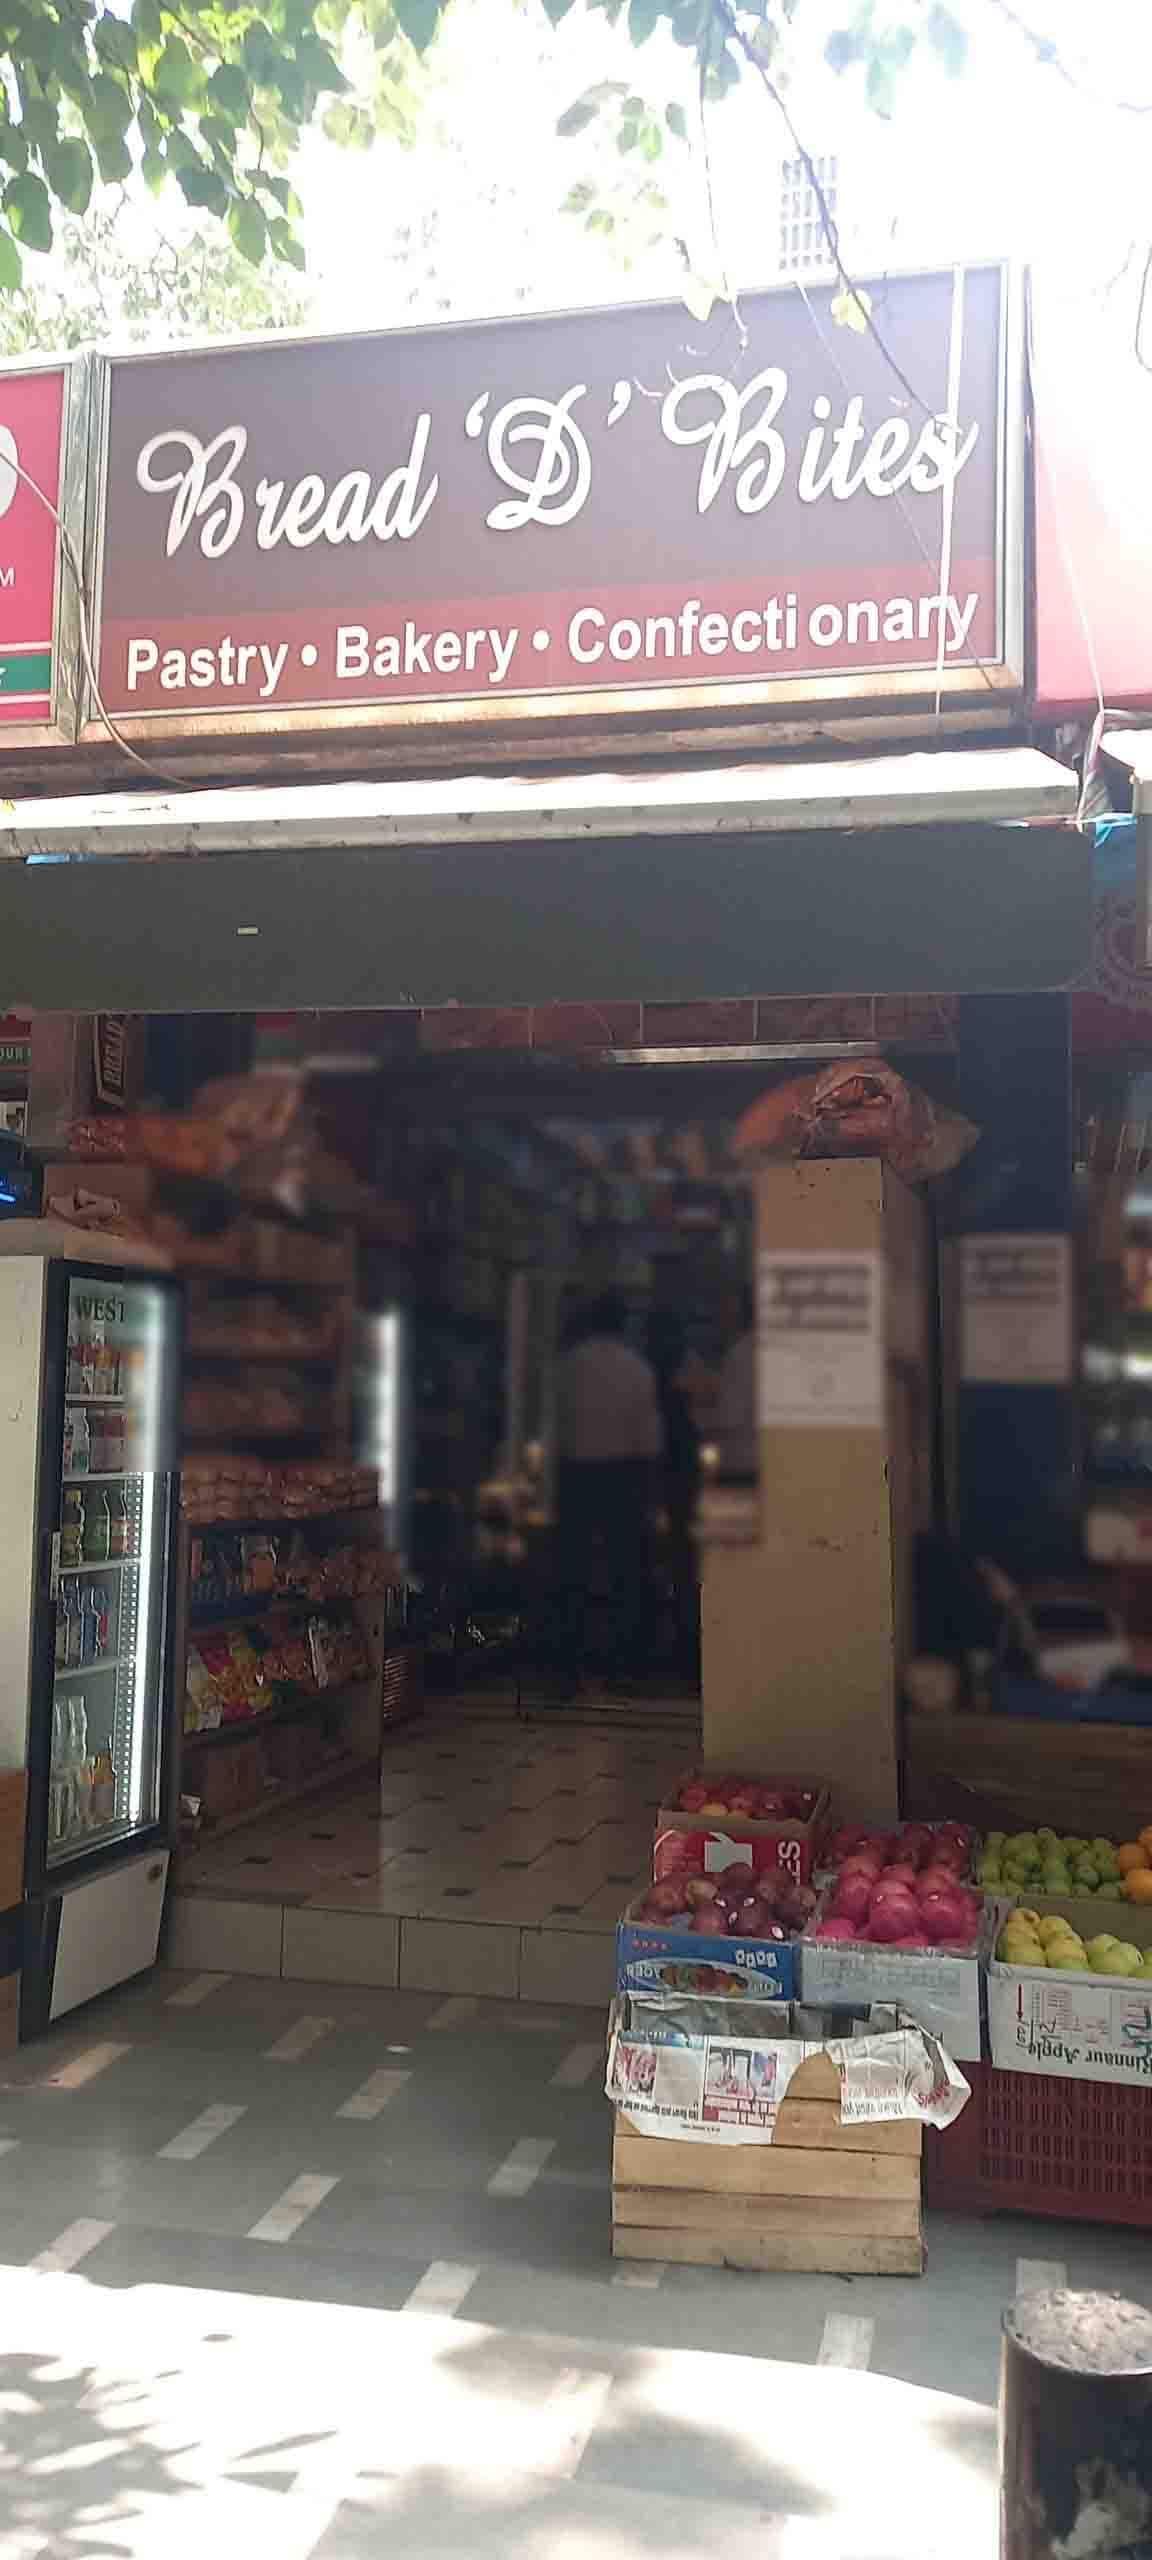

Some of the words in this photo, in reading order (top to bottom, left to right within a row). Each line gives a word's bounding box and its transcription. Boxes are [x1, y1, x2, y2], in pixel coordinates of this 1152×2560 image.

[136, 412, 438, 558] Bread
[661, 367, 979, 513] Bites
[126, 635, 289, 697] Pastry
[335, 622, 519, 683] Bakery
